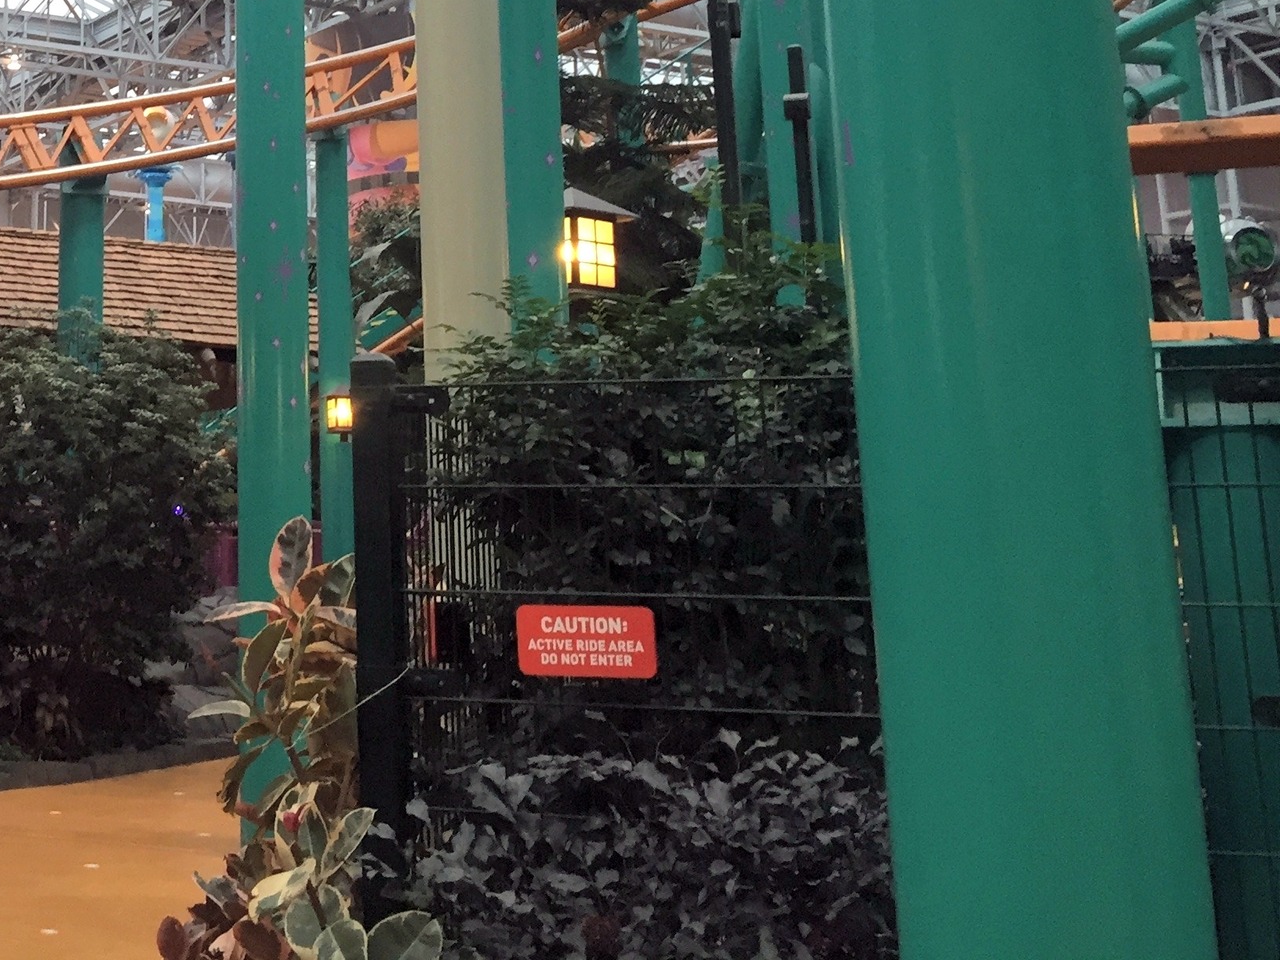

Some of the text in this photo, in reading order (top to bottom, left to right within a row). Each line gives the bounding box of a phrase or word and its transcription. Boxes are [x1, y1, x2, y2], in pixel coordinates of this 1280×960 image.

[540, 616, 628, 635] CAUTION:
[528, 638, 644, 653] ACTIVE RIDE AREA
[540, 652, 633, 667] DO NOT ENTER
